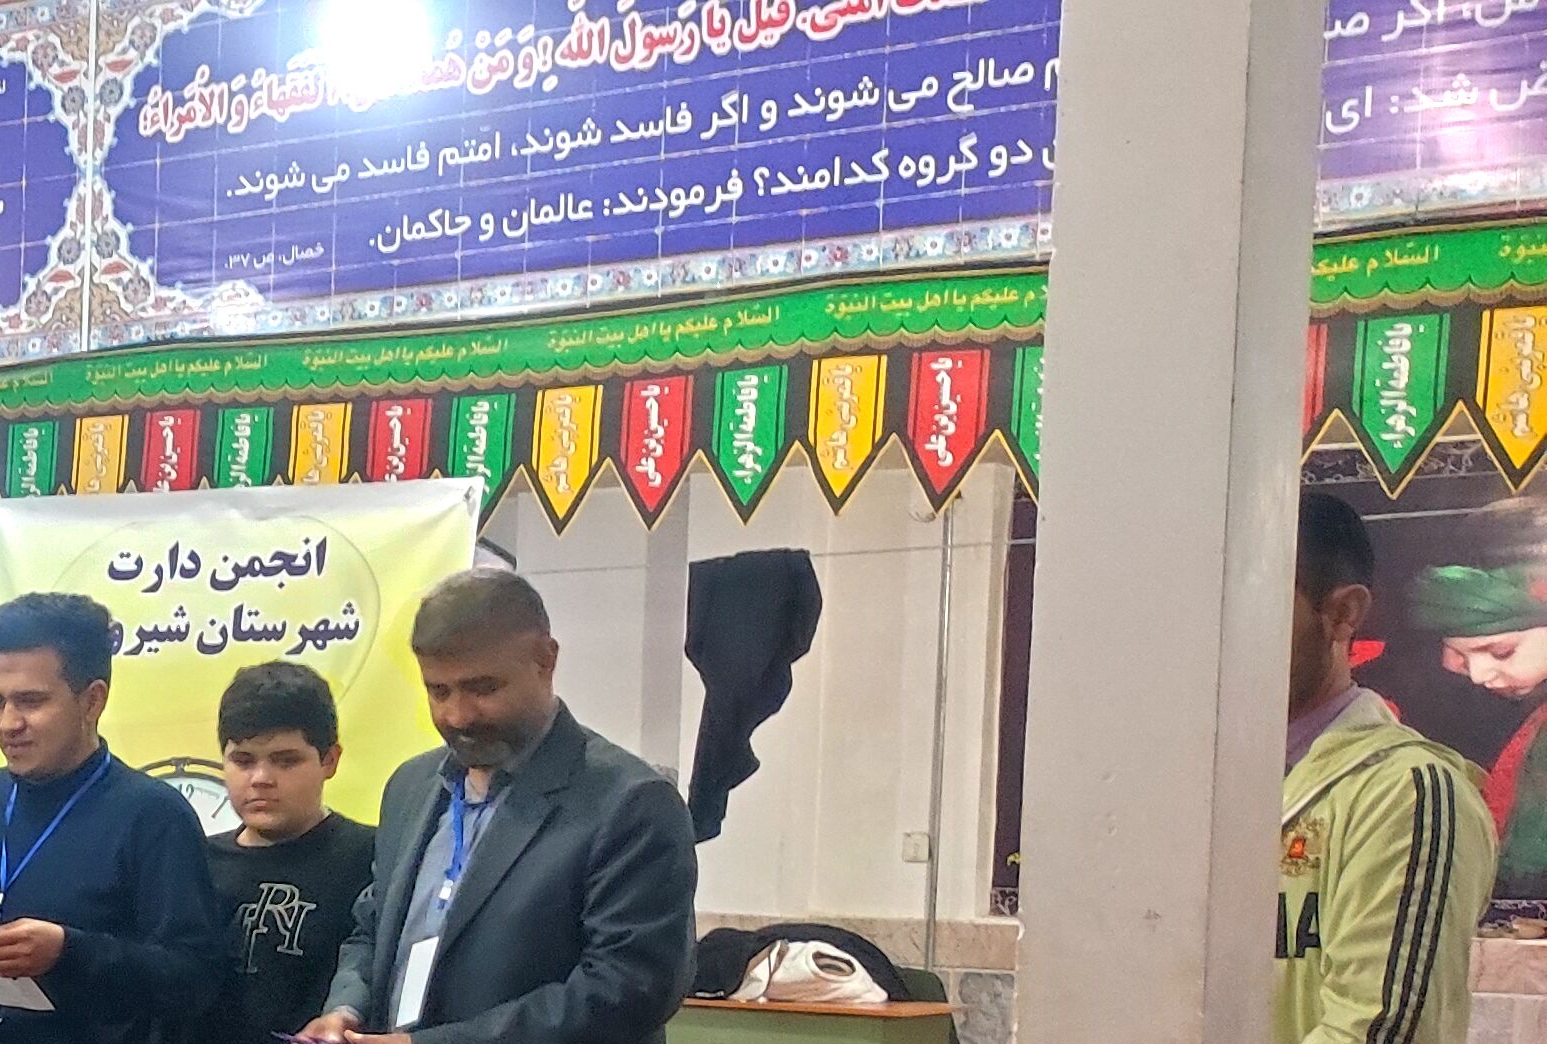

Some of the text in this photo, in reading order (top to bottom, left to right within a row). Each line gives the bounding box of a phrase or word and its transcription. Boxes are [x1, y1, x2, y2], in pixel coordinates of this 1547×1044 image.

[787, 75, 880, 120] شوند
[888, 75, 939, 107] می
[948, 57, 1034, 113] صالح
[610, 102, 693, 145] فاسد
[700, 91, 749, 140] اگر
[759, 99, 778, 132] و
[311, 162, 351, 194] می
[358, 140, 431, 180] فاسد
[898, 133, 979, 187] گروه
[989, 137, 1034, 177] دو
[478, 212, 495, 241] و
[502, 192, 593, 238] عالمان
[253, 252, 275, 270] ص
[107, 535, 328, 594] انجمن دارت
[109, 600, 361, 657] شهرستان شیرو
